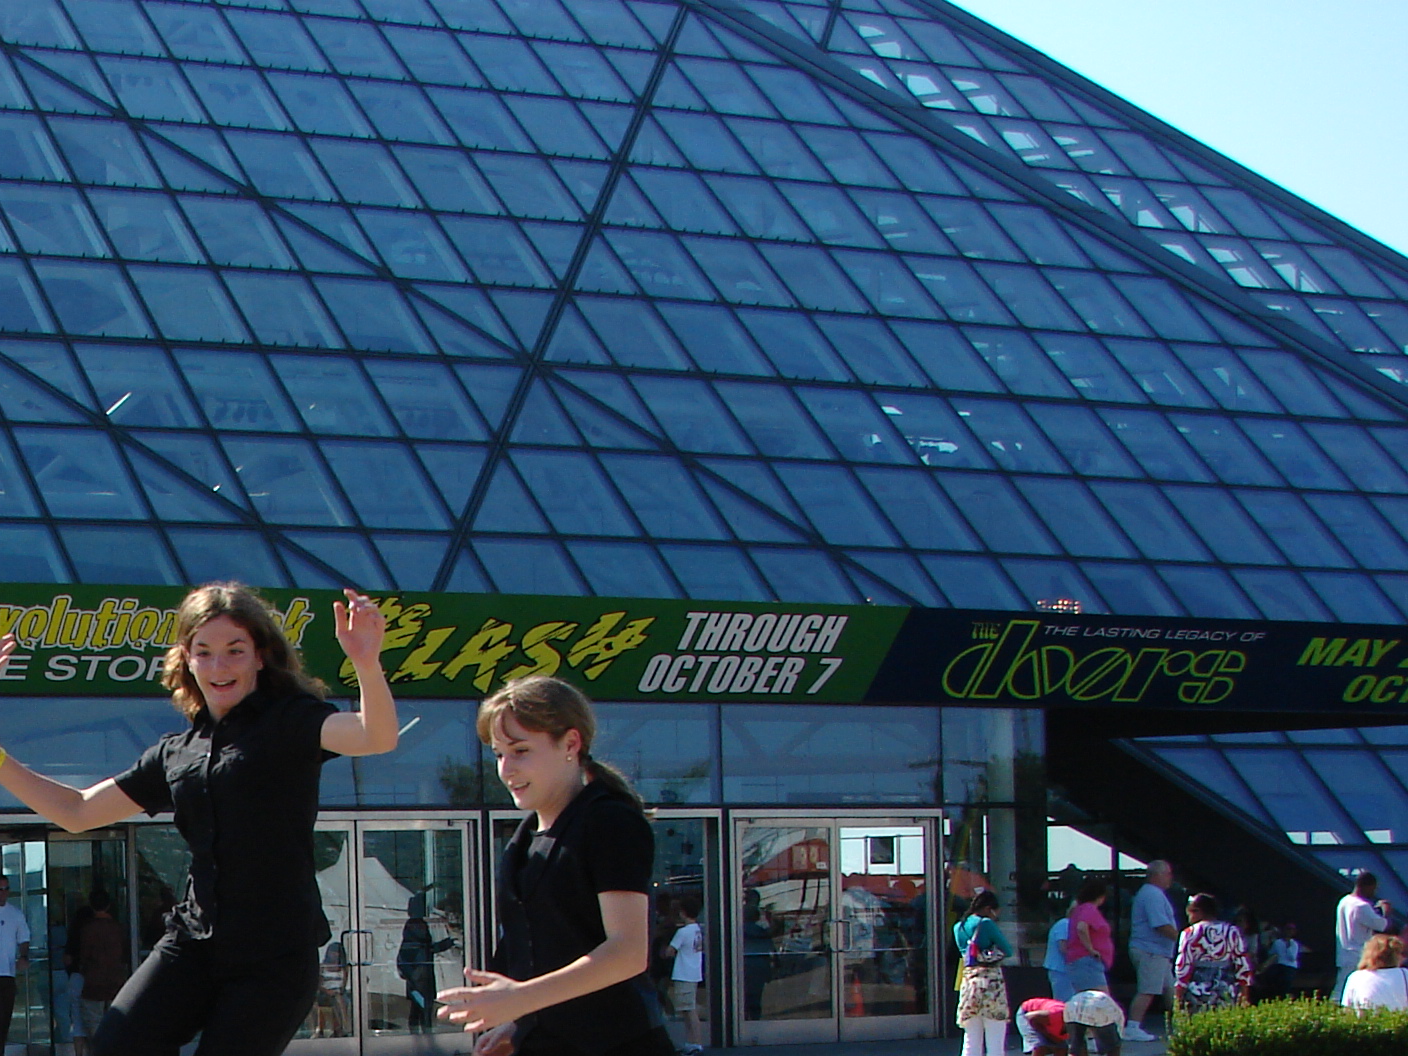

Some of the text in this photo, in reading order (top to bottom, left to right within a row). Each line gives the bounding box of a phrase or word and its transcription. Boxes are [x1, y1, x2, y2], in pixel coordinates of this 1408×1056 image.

[346, 597, 432, 633] he
[677, 611, 849, 653] THROUGH
[1044, 625, 1267, 642] THE LASTING LEGACY OF
[1296, 636, 1402, 668] MAY
[637, 653, 843, 694] OCTOBER 7
